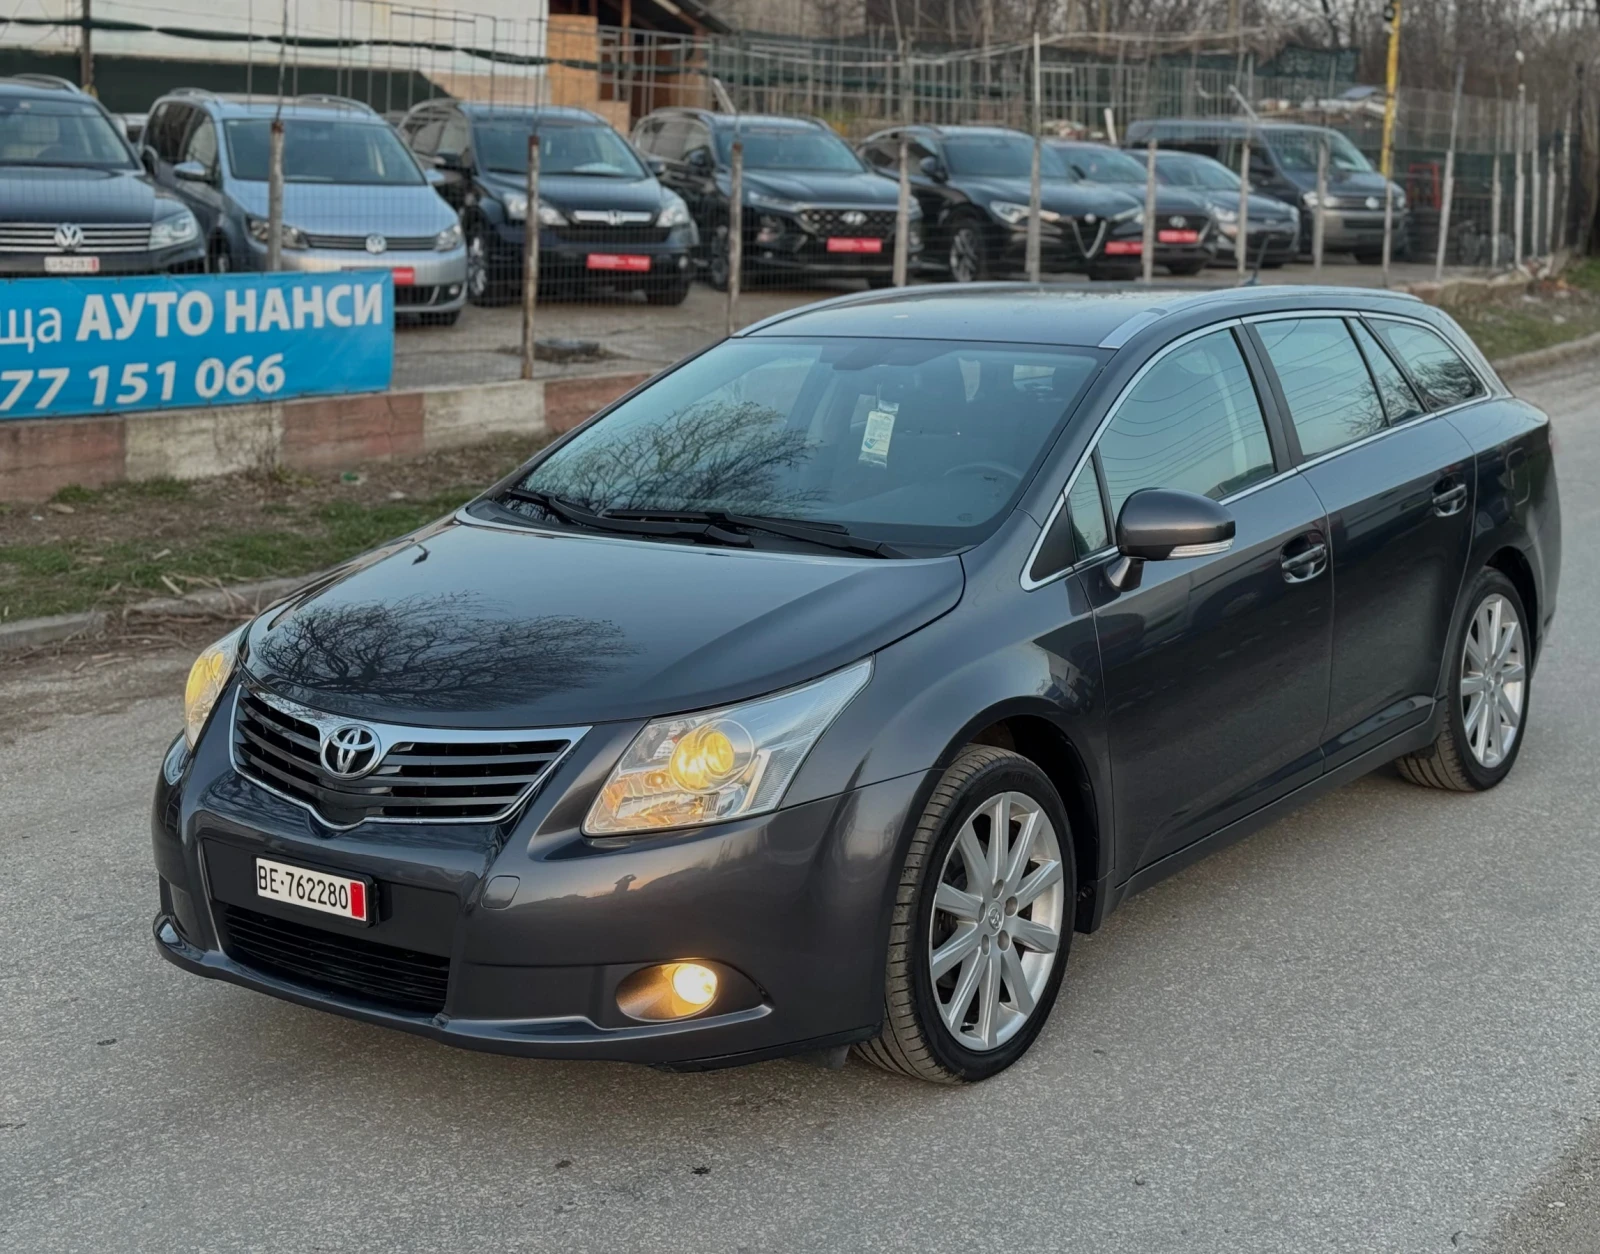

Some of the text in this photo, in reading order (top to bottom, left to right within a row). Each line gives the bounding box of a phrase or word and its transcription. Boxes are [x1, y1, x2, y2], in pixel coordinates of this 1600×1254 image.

[76, 291, 214, 341] АУТО
[225, 282, 383, 334] НАНСИ
[0, 353, 286, 411] 77 151 066
